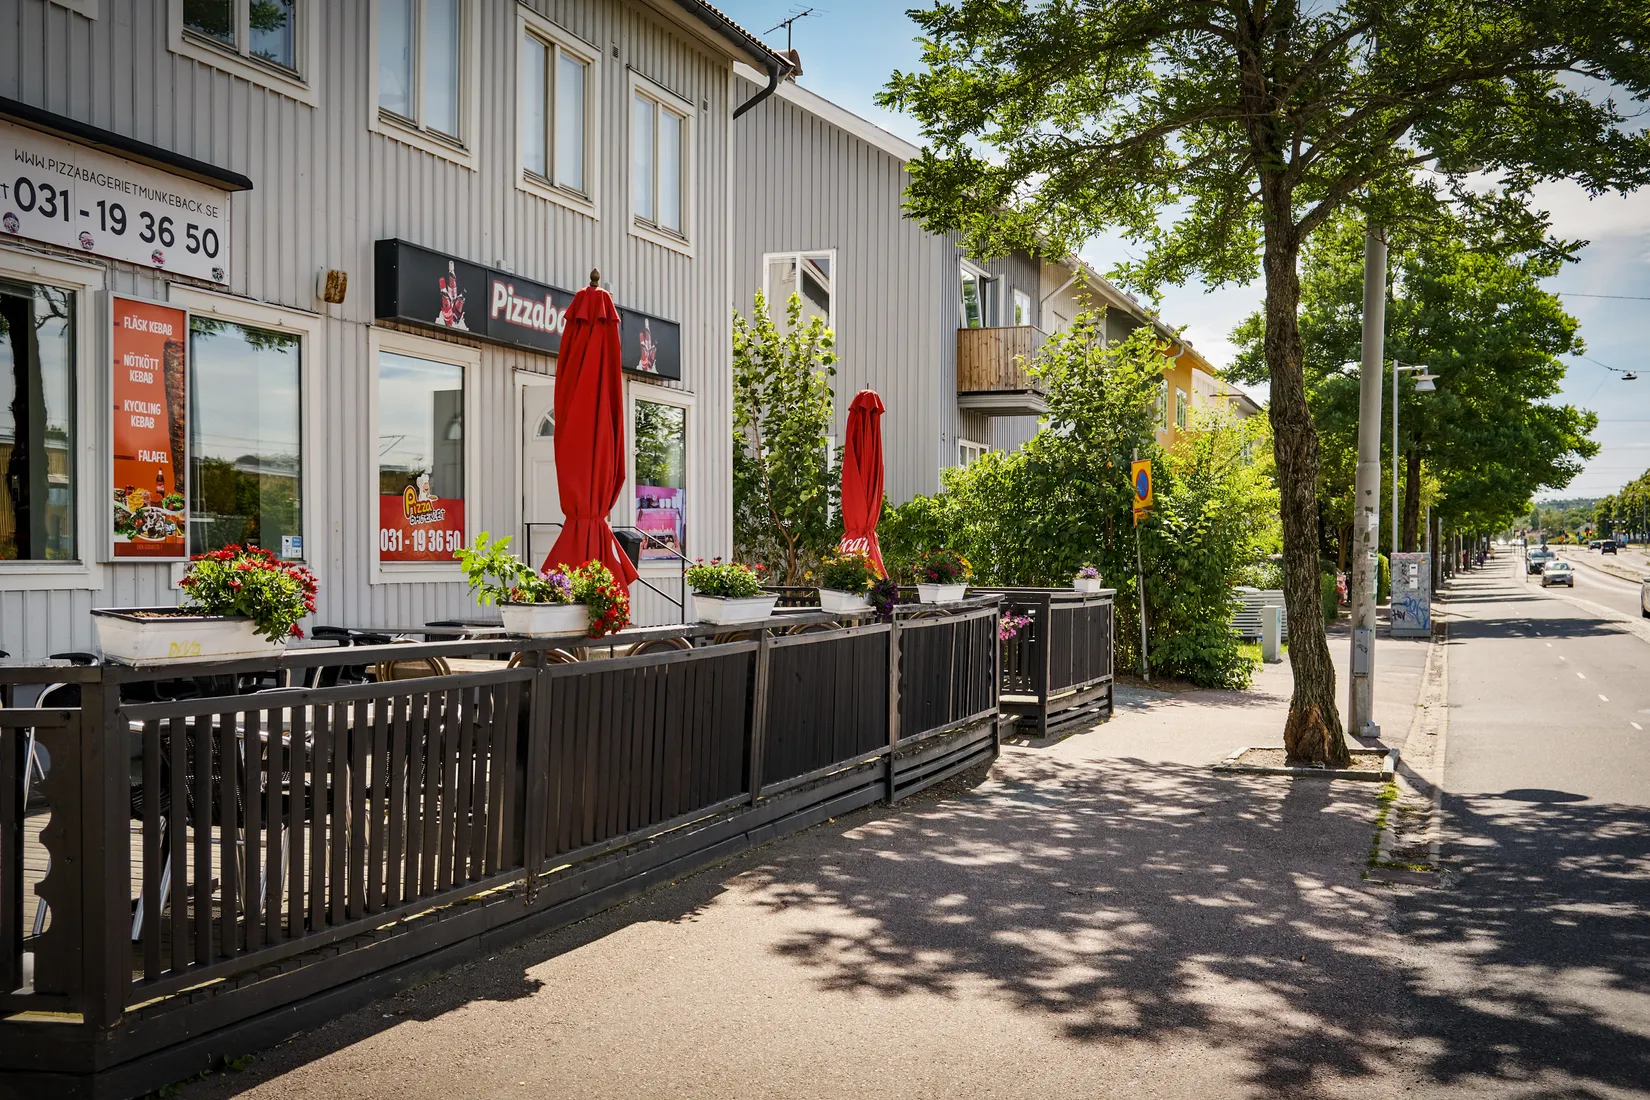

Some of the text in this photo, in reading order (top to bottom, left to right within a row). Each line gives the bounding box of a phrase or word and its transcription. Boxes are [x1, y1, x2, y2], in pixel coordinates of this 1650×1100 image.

[14, 148, 219, 219] WWW.PIZZABAGERIETMUNKEBACK.SE
[138, 211, 175, 248] 36
[185, 223, 219, 259] 50
[123, 314, 173, 336] FLÄSK KEBAB
[123, 351, 159, 371] NÖTKÖTT
[129, 369, 154, 385] KEBAB
[124, 399, 161, 415] KYCKLING
[130, 415, 155, 429] KEBAB
[138, 449, 169, 464] FALAFEL
[404, 486, 433, 517] Pizza
[428, 529, 444, 552] 36
[445, 530, 461, 552] 50
